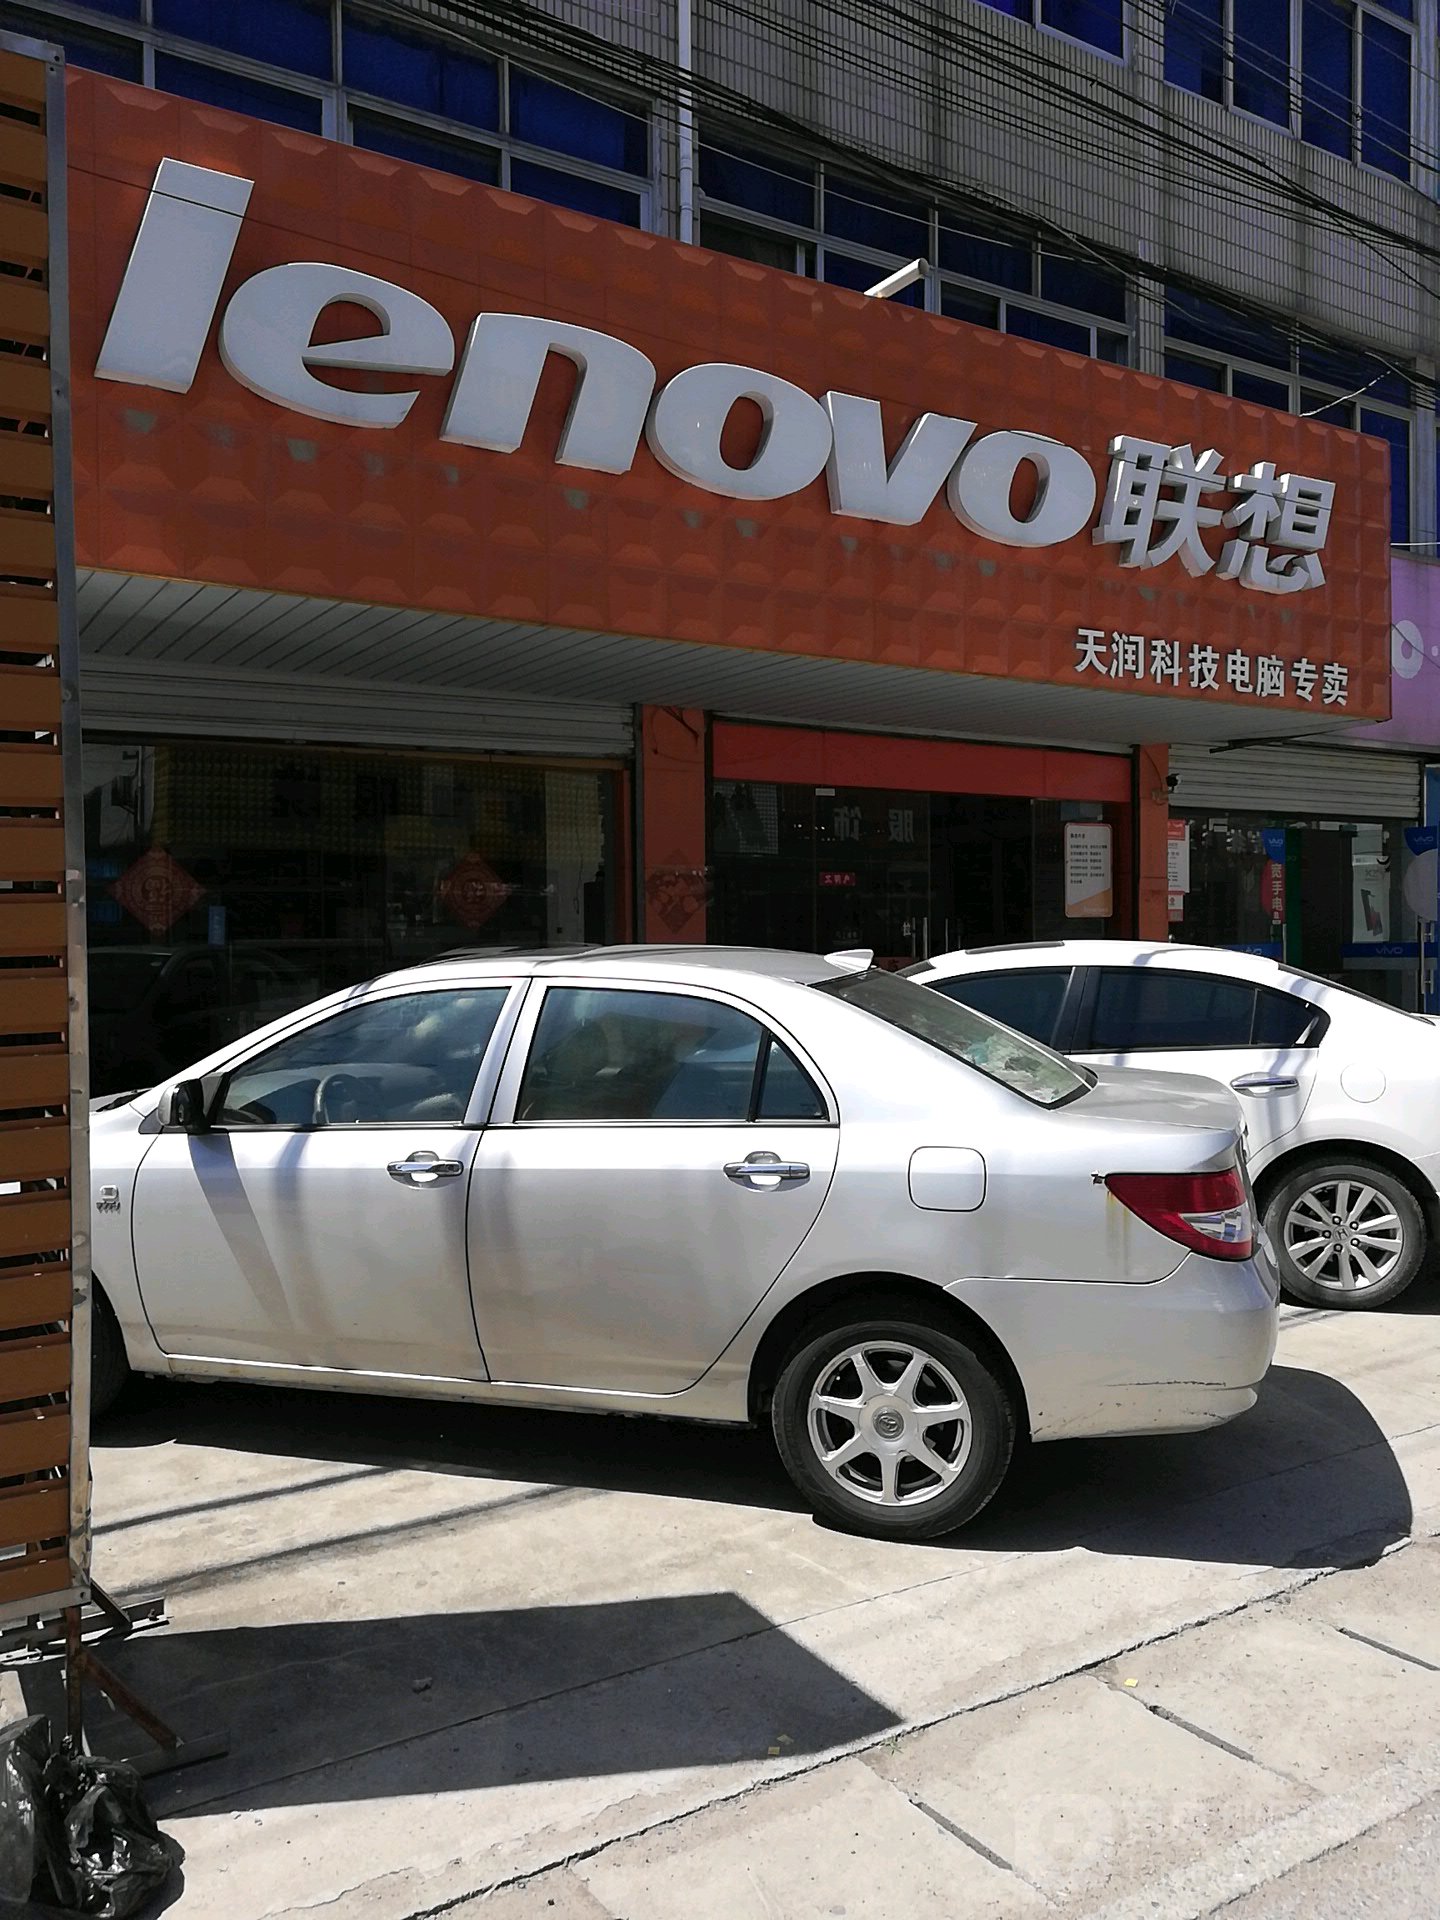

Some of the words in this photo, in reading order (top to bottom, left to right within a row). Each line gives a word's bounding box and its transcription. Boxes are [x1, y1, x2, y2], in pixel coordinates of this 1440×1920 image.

[94, 157, 1097, 547] lenovo
[1092, 434, 1336, 595] 联想
[1075, 627, 1349, 707] 天润科技电脑专卖
[1413, 835, 1434, 843] vivo
[1375, 945, 1404, 955] vivo
